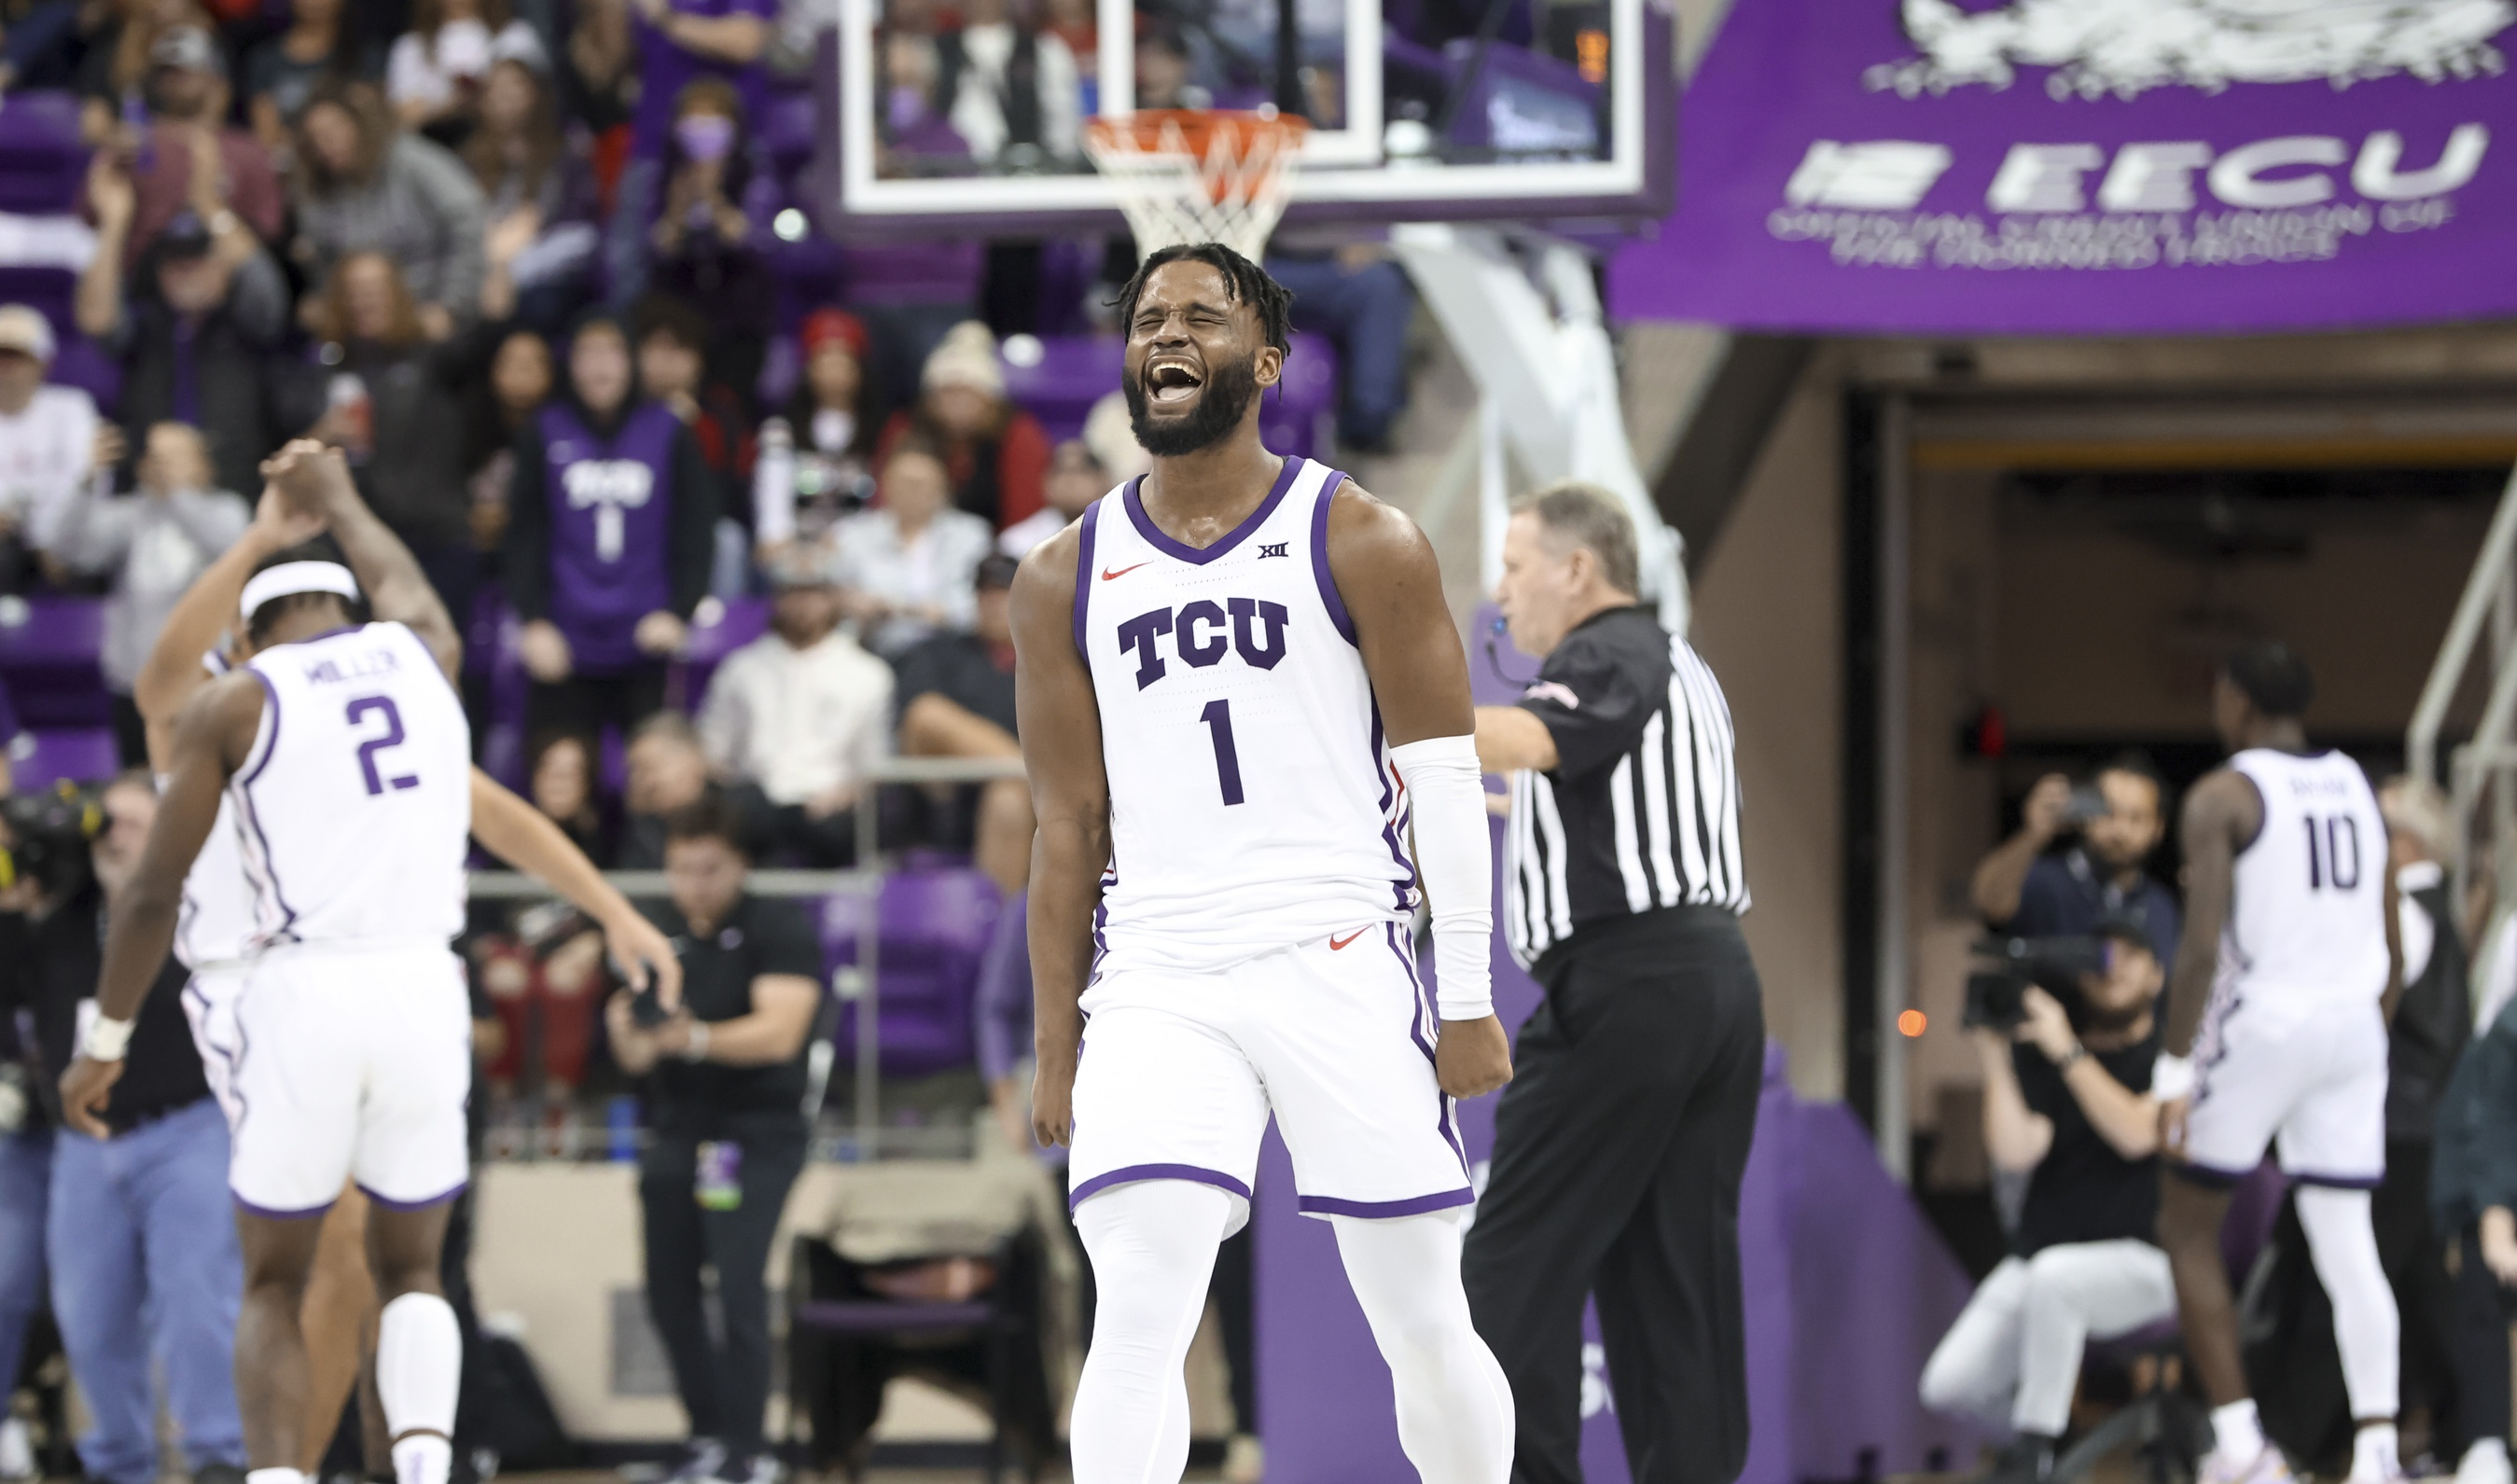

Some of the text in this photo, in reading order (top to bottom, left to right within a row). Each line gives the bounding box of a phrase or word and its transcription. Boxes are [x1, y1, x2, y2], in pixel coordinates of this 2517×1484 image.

[1986, 122, 2489, 214] EECU
[1117, 597, 1289, 692] TCU
[346, 695, 420, 796] 2
[1200, 698, 1245, 807] 1
[2302, 814, 2358, 890] 10
